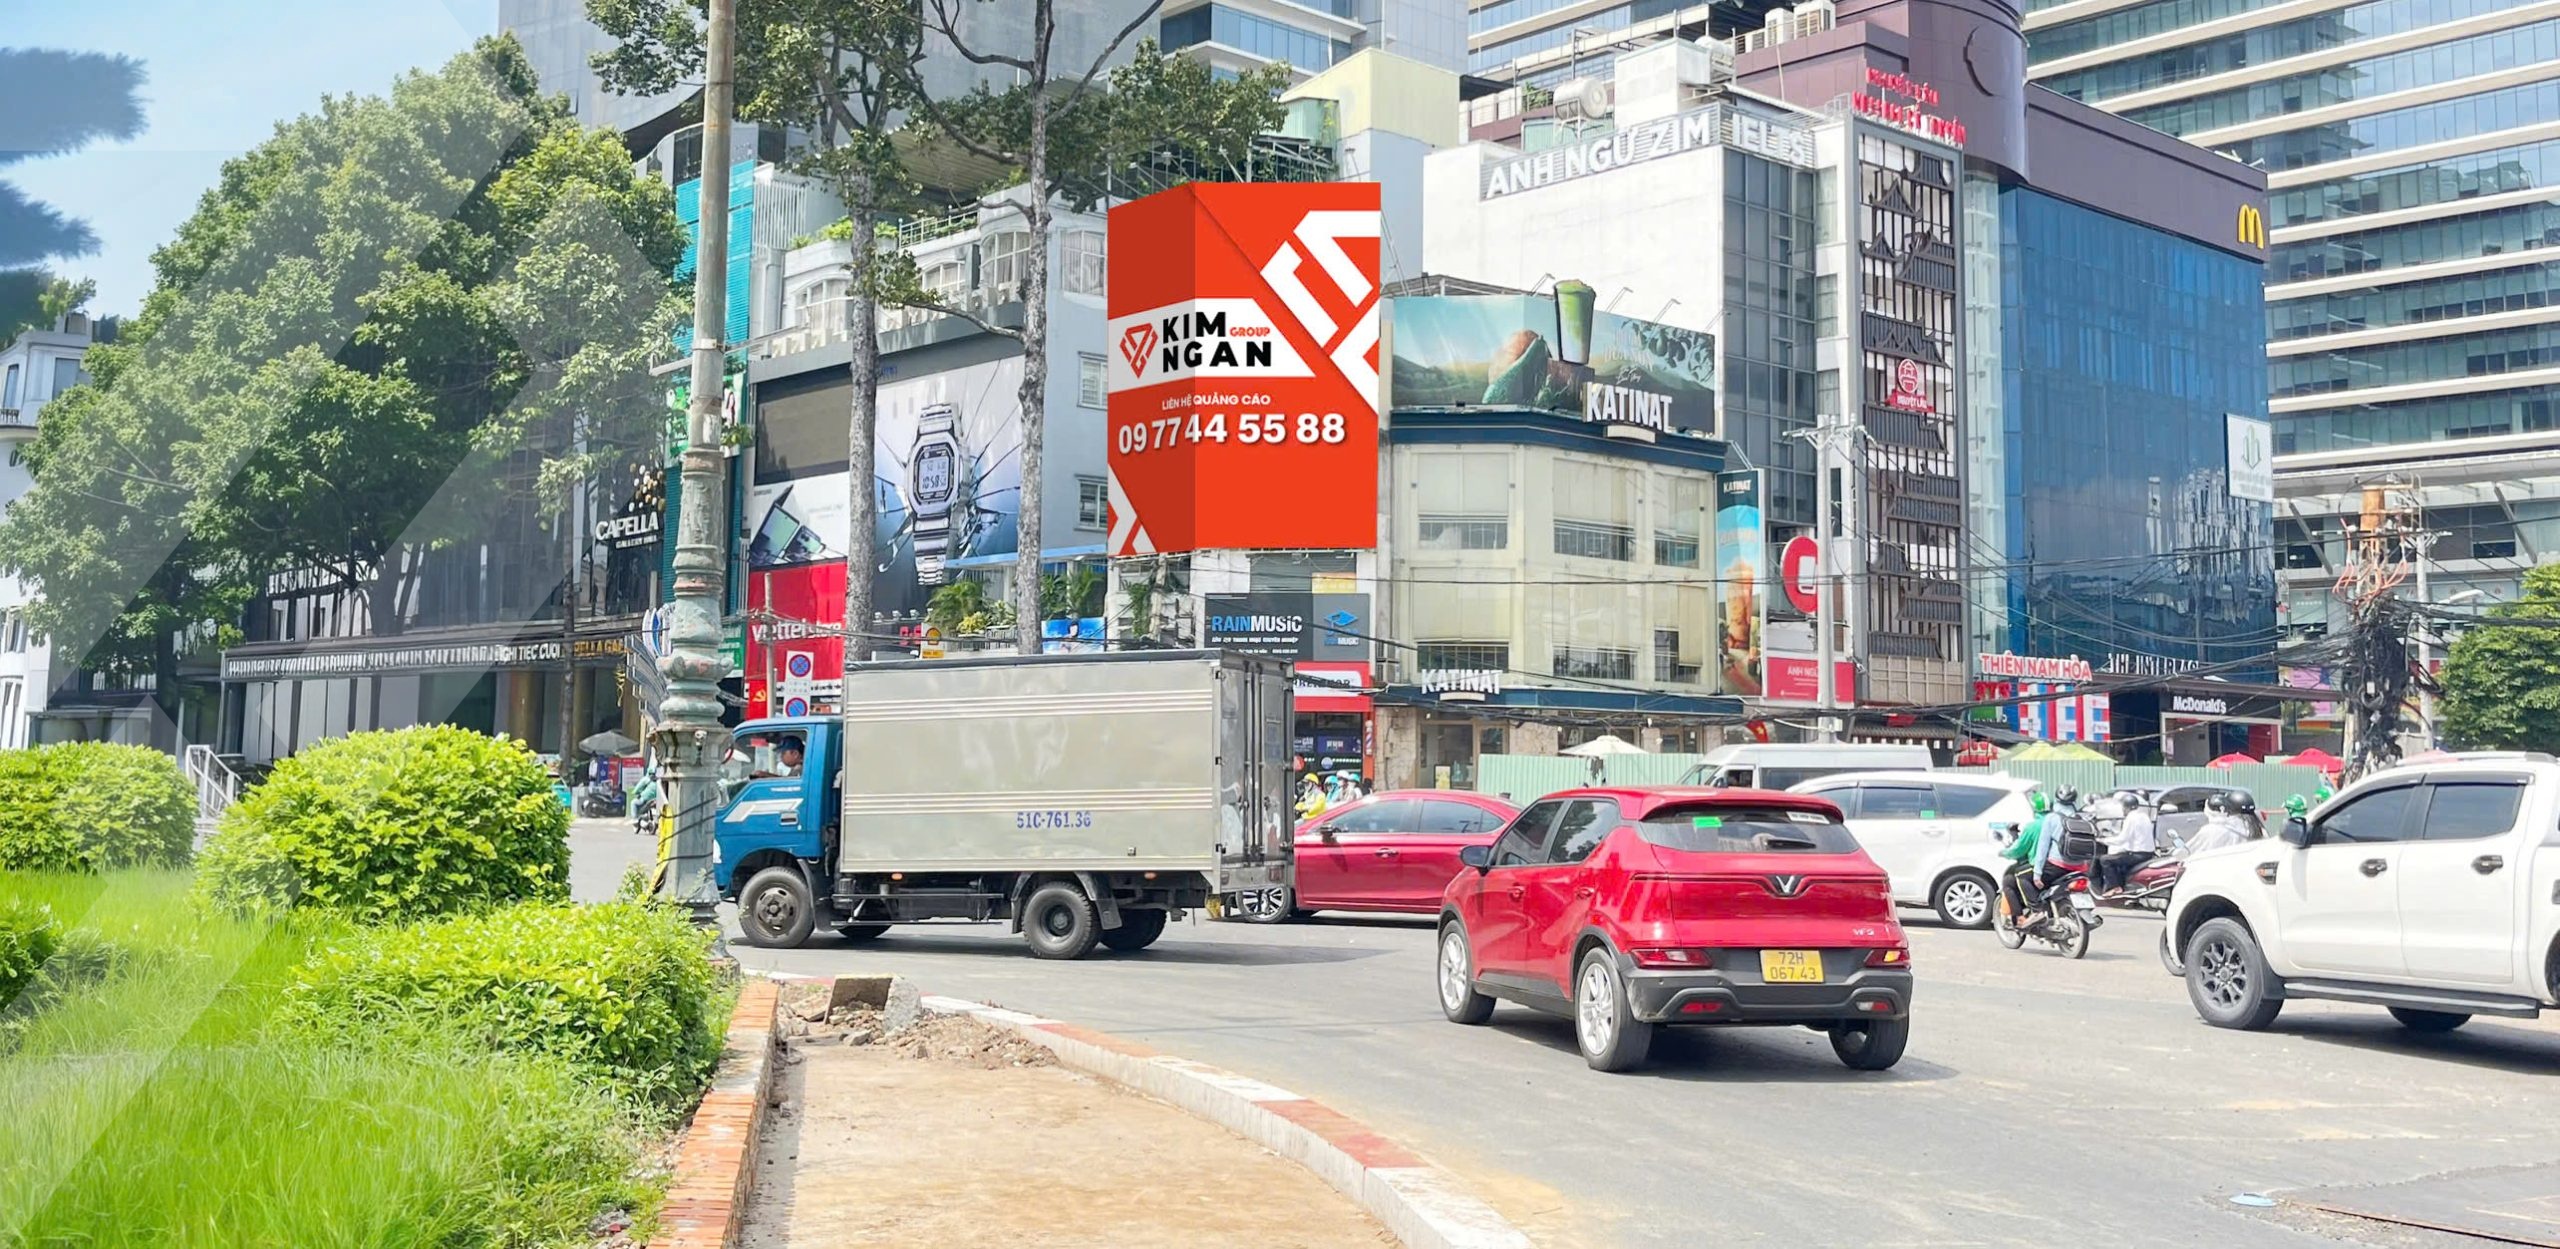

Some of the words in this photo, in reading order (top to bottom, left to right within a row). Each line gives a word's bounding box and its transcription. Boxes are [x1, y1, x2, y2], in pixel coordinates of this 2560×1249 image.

[1486, 154, 1553, 199] ANH
[1648, 112, 1710, 155] ZIM
[1731, 112, 1806, 167] IELTS
[1162, 311, 1226, 344] KIM
[1229, 326, 1271, 338] GROUP
[1162, 341, 1272, 374] NGAN
[1162, 396, 1180, 411] LIÊN
[1181, 394, 1192, 408] HỆ
[1193, 391, 1240, 406] QUẢNG
[1241, 392, 1272, 406] CÁO
[1585, 381, 1673, 433] KATINAT
[1118, 422, 1147, 454] 09
[1151, 416, 1182, 449] 77
[1184, 413, 1228, 443] 44
[1237, 413, 1287, 443] 55
[1295, 412, 1346, 443] 88
[1723, 479, 1752, 493] KATINAT
[595, 511, 659, 540] CAPELLA
[1979, 650, 2025, 676] THIÊN
[2025, 657, 2060, 678] NAM
[2062, 654, 2093, 681] HÒA
[1421, 668, 1503, 695] KATINAT
[2173, 695, 2227, 714] McDonald's
[1778, 951, 1805, 965] 72H
